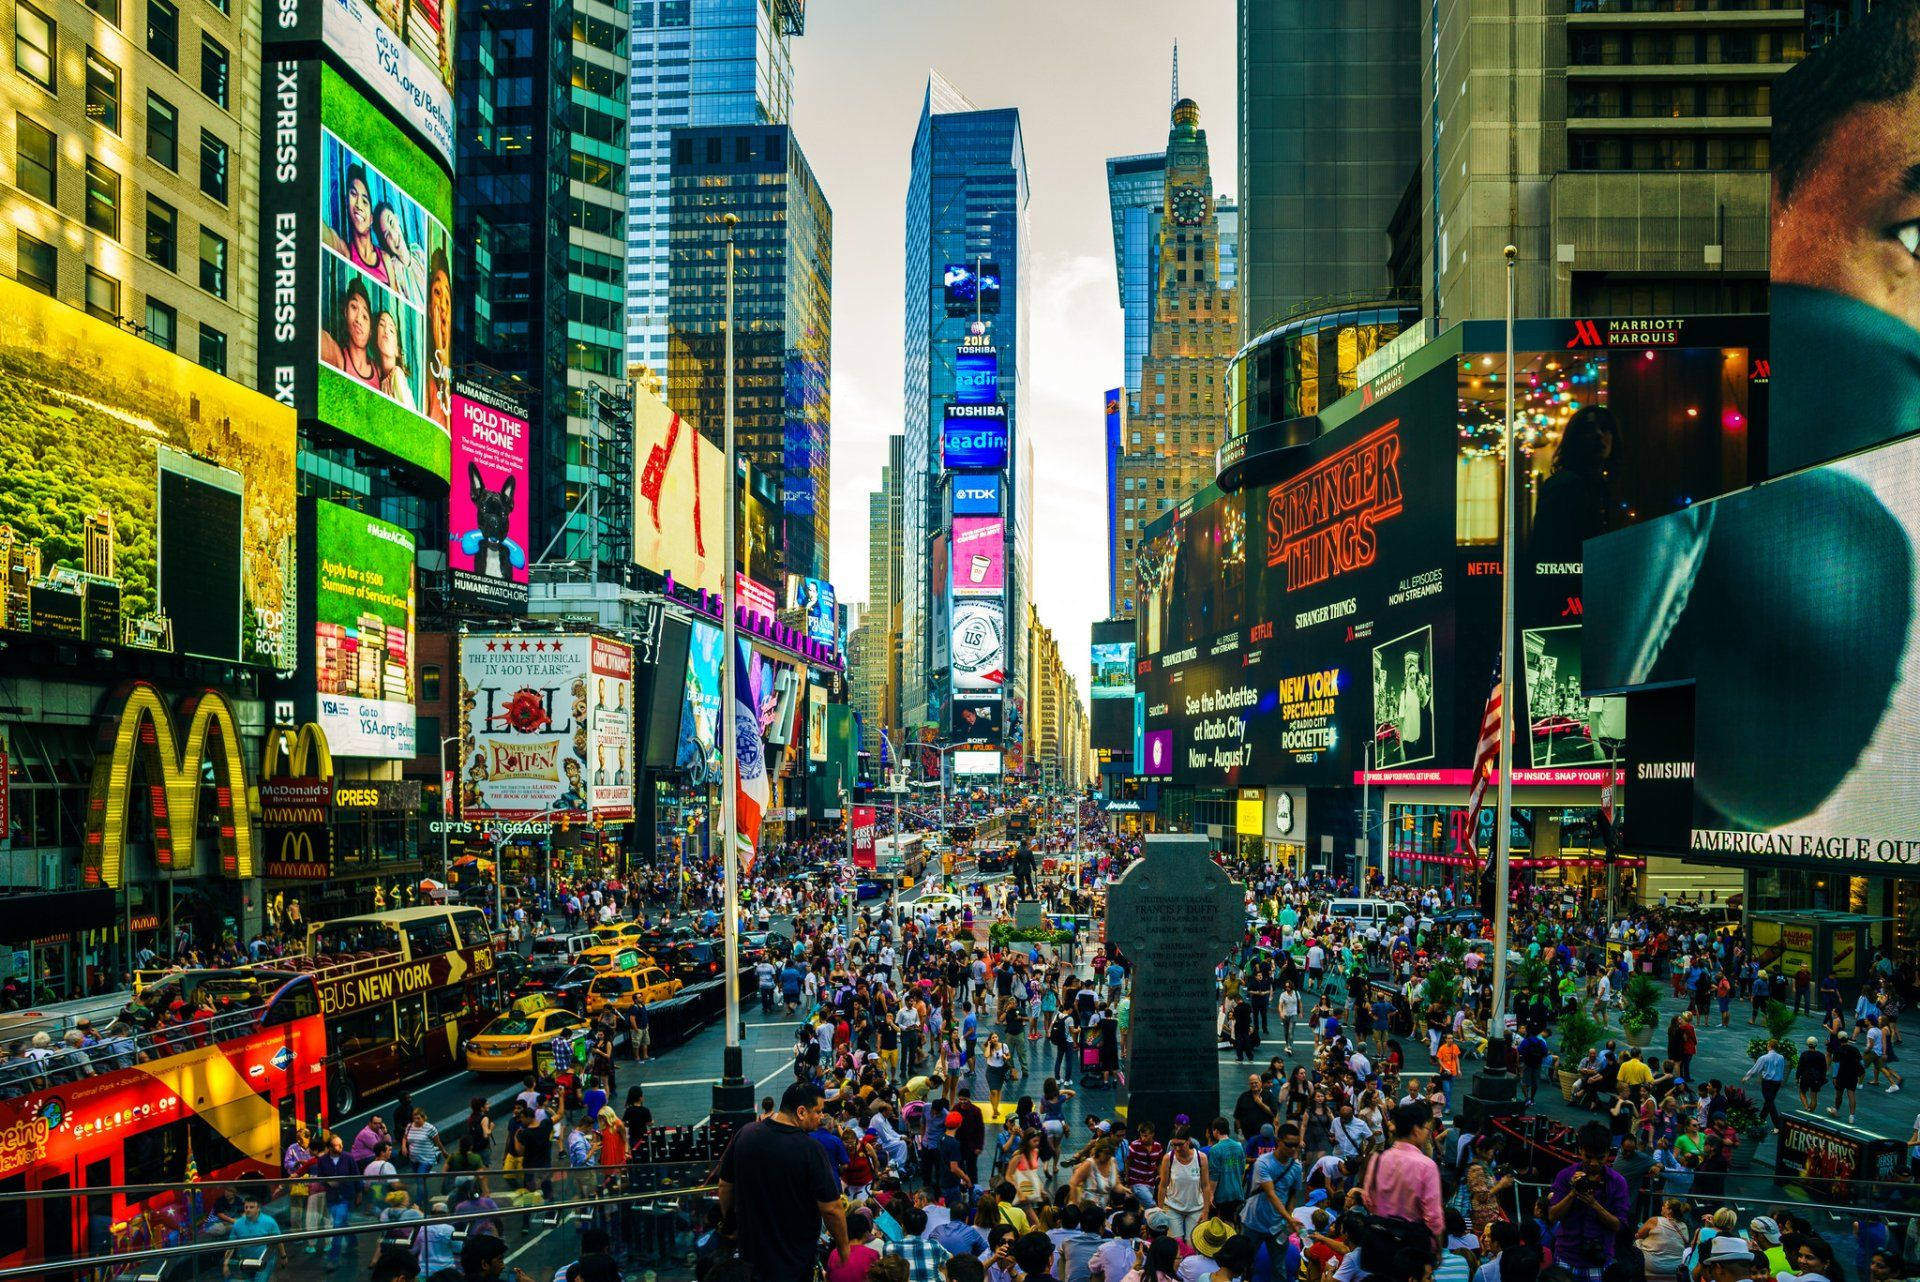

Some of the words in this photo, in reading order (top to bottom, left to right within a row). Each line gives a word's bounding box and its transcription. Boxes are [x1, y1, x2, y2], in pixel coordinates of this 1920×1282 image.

[375, 27, 388, 48] Go
[390, 43, 399, 59] to
[276, 60, 298, 183] EXPRESS
[274, 212, 297, 342] EXPRESS
[1609, 319, 1684, 330] MARRIOTT
[964, 335, 990, 346] 2016
[1609, 333, 1675, 343] MARQUIS
[957, 346, 996, 354] TOSHIBA
[1374, 362, 1406, 387] MARRIOTT
[1374, 376, 1402, 399] MARQUIS
[456, 382, 528, 419] HUMANEWATCH.ORG
[948, 406, 1004, 416] TOSHIBA
[464, 403, 498, 428] HOLD
[500, 417, 522, 438] THE
[472, 423, 514, 451] PHONE
[965, 489, 995, 499] TDK
[1268, 432, 1403, 556] STRANGER
[1286, 508, 1377, 592] THINGS
[322, 559, 347, 579] Apply
[347, 565, 359, 580] for
[360, 572, 364, 582] a
[365, 571, 383, 586] $500
[1399, 579, 1411, 590] ALL
[1412, 568, 1443, 588] EPISODES
[322, 577, 356, 596] Summer
[356, 586, 366, 598] of
[366, 587, 391, 605] Service
[454, 579, 528, 603] HUMANEWATCH.ORG
[1388, 591, 1405, 606] NOW
[1405, 582, 1443, 602] STREAMING
[255, 607, 283, 629] TOP
[1295, 603, 1329, 630] STRANGER
[1328, 598, 1357, 621] THINGS
[1223, 632, 1239, 643] EPISODES
[1250, 621, 1273, 643] NETFLIX
[255, 640, 283, 656] ROCK
[468, 654, 489, 663] THE
[489, 654, 537, 663] FUNNIEST
[538, 654, 580, 663] MUSICAL
[1162, 650, 1182, 668] STRANGER
[1181, 646, 1197, 661] THINGS
[1211, 645, 1220, 656] NOW
[1220, 642, 1239, 654] STREAMING
[485, 665, 498, 675] IN
[500, 665, 523, 675] 400
[1280, 675, 1306, 704] NEW
[1307, 668, 1339, 700] YORK
[323, 701, 338, 714] YSA
[360, 705, 369, 716] Go
[371, 707, 379, 717] to
[480, 686, 570, 734] LOL
[1185, 695, 1200, 715] See
[1201, 691, 1214, 713] the
[1215, 685, 1258, 711] Rockettes
[1283, 698, 1335, 720] SPECTACULAR
[1194, 721, 1204, 742] at
[1203, 718, 1226, 740] Radio
[1226, 714, 1246, 743] City
[1297, 718, 1314, 729] RADIO
[1314, 717, 1327, 727] CITY
[499, 744, 549, 752] SOMETHING
[1188, 748, 1207, 769] Now
[1213, 744, 1244, 774] August
[1245, 743, 1252, 766] 7
[1296, 753, 1313, 763] CHASE
[1524, 772, 1553, 781] INSIDE.
[1554, 772, 1576, 780] SNAP
[1579, 772, 1600, 780] YOUR
[1638, 762, 1695, 780] SAMSUN
[262, 785, 329, 795] McDonald's
[430, 821, 472, 834] GIFTS
[855, 825, 875, 838] JERSEY
[856, 838, 872, 849] BOYS
[1692, 831, 1793, 856] AMERICAN
[1799, 835, 1871, 861] EAGLE
[1135, 905, 1175, 914] FRANCIS
[1185, 905, 1219, 914] DUFFY
[473, 949, 485, 963] BIG
[324, 982, 356, 1014] BUS
[358, 971, 393, 1004] NEW
[396, 962, 432, 994] YORK
[72, 1085, 98, 1100] Central
[99, 1082, 115, 1094] Park
[1784, 1128, 1826, 1156] JERSEY
[1827, 1140, 1856, 1171] BOYS
